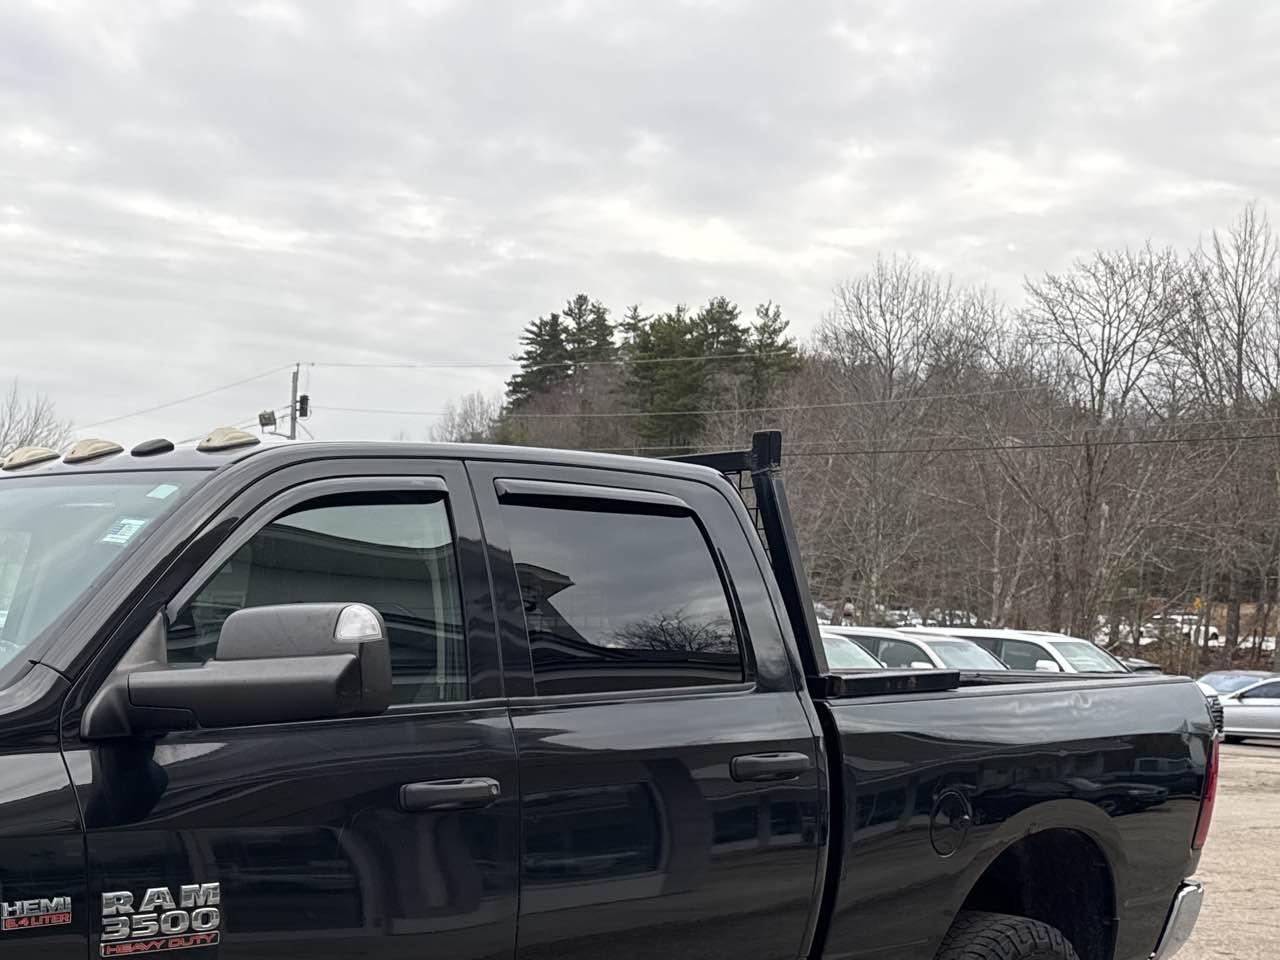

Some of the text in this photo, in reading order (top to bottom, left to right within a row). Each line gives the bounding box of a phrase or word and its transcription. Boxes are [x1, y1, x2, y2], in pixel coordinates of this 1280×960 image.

[0, 896, 72, 917] HEMI
[101, 882, 221, 915] RAM
[5, 913, 70, 929] 6.4 LITER
[101, 907, 221, 941] 3500
[106, 934, 216, 955] HEAVY DUTY
